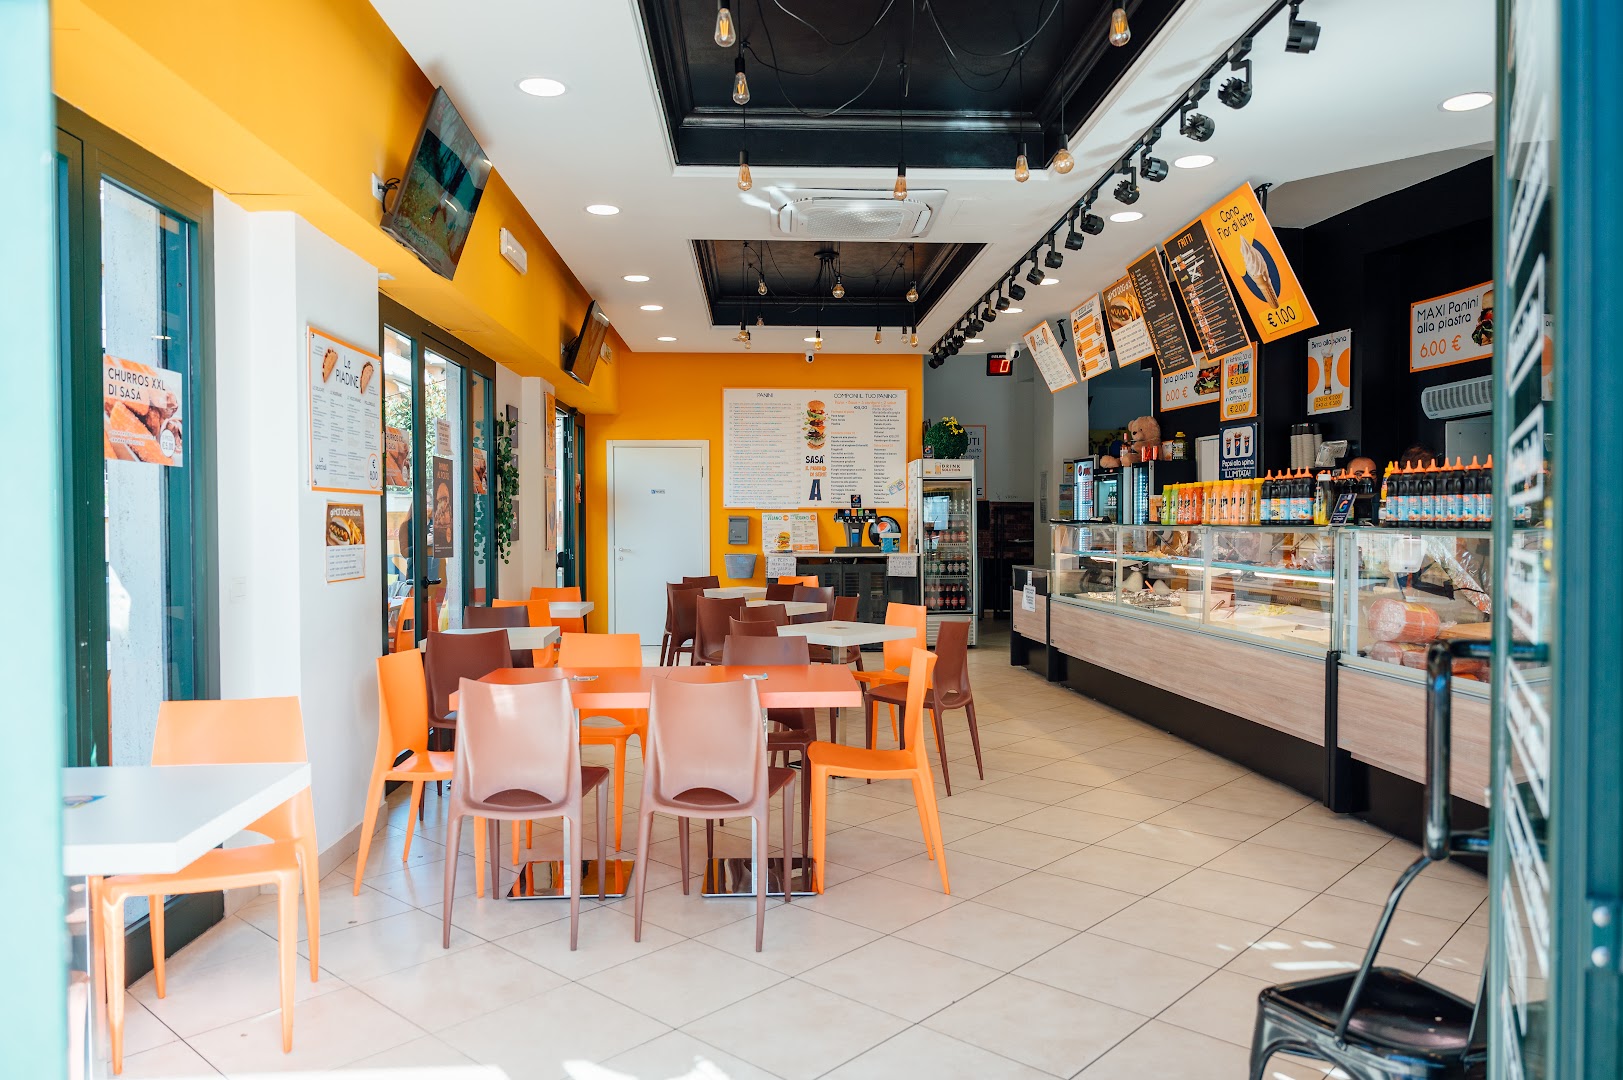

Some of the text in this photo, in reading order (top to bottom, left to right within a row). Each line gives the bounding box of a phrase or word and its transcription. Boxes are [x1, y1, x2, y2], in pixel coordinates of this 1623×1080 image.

[1219, 206, 1240, 223] Cono
[1217, 212, 1255, 240] Fior di latte
[1416, 296, 1479, 322] MAXI Panini
[1417, 313, 1472, 334] alla piastra
[1420, 338, 1447, 358] 6.00
[344, 355, 351, 370] Le
[1000, 360, 1010, 372] 0
[108, 368, 166, 391] CHURROS XXL
[336, 369, 359, 388] PIADINE
[108, 384, 117, 396] DI
[809, 479, 822, 500] A
